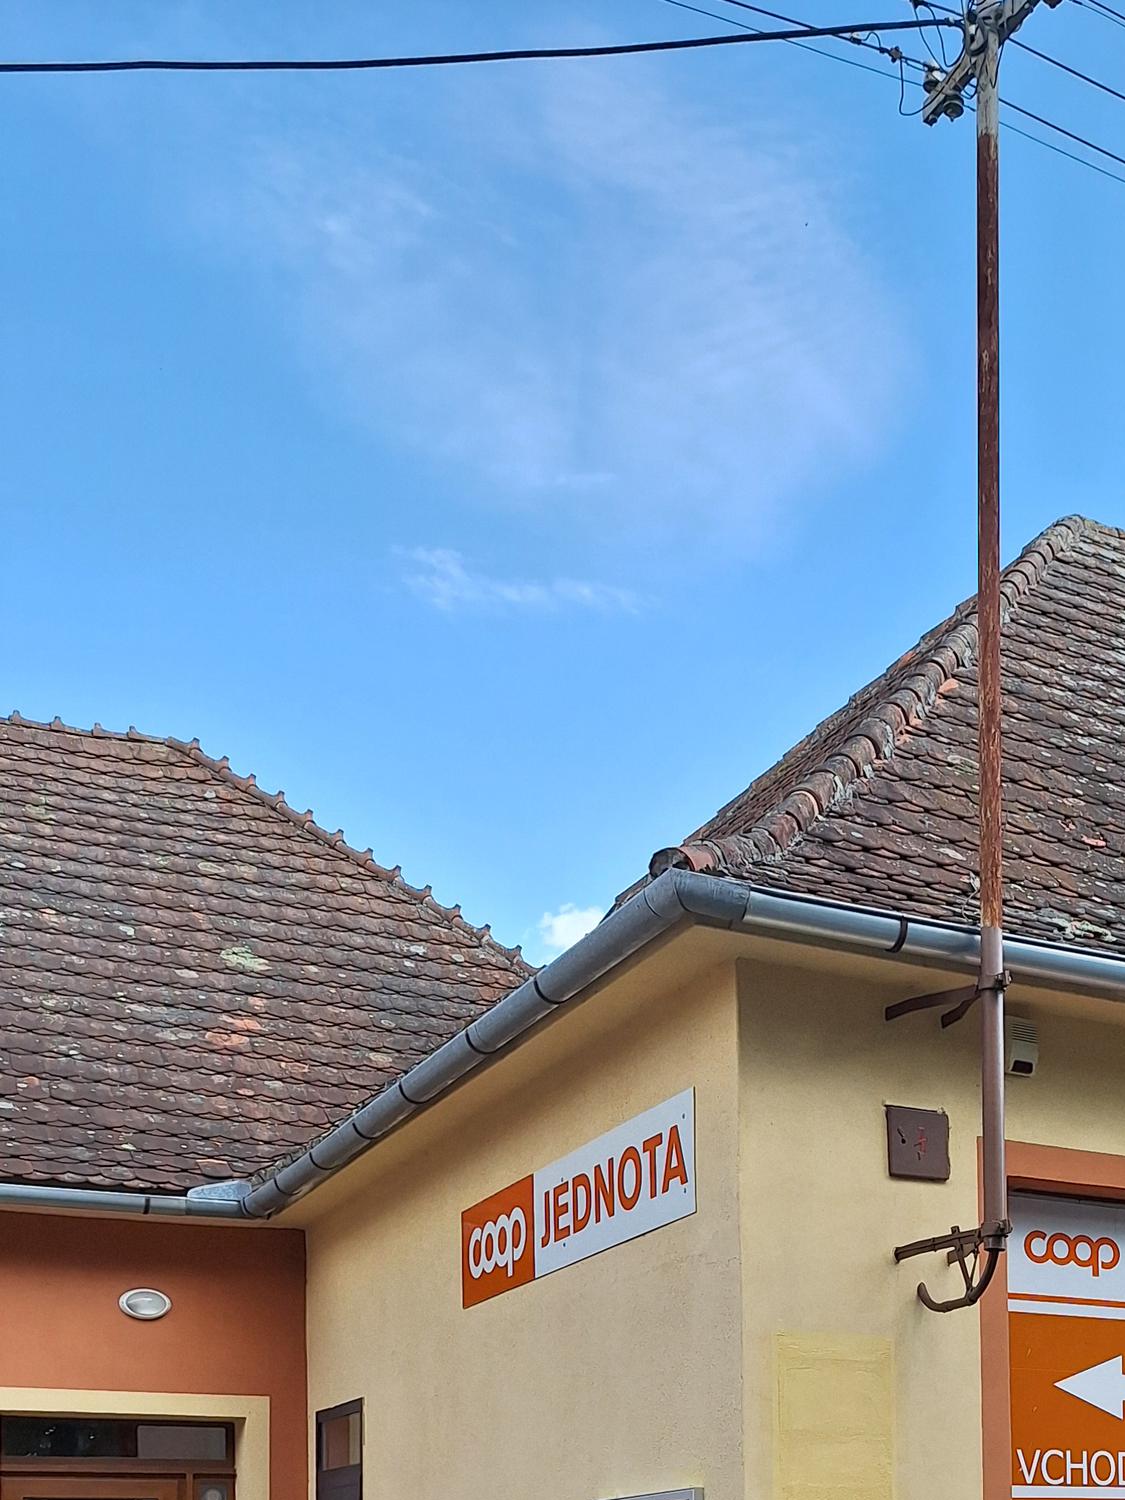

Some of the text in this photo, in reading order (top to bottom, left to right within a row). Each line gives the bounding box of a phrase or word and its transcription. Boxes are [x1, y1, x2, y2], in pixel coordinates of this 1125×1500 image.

[468, 1124, 688, 1279] coop JEDNOTA
[1024, 1230, 1120, 1277] coop
